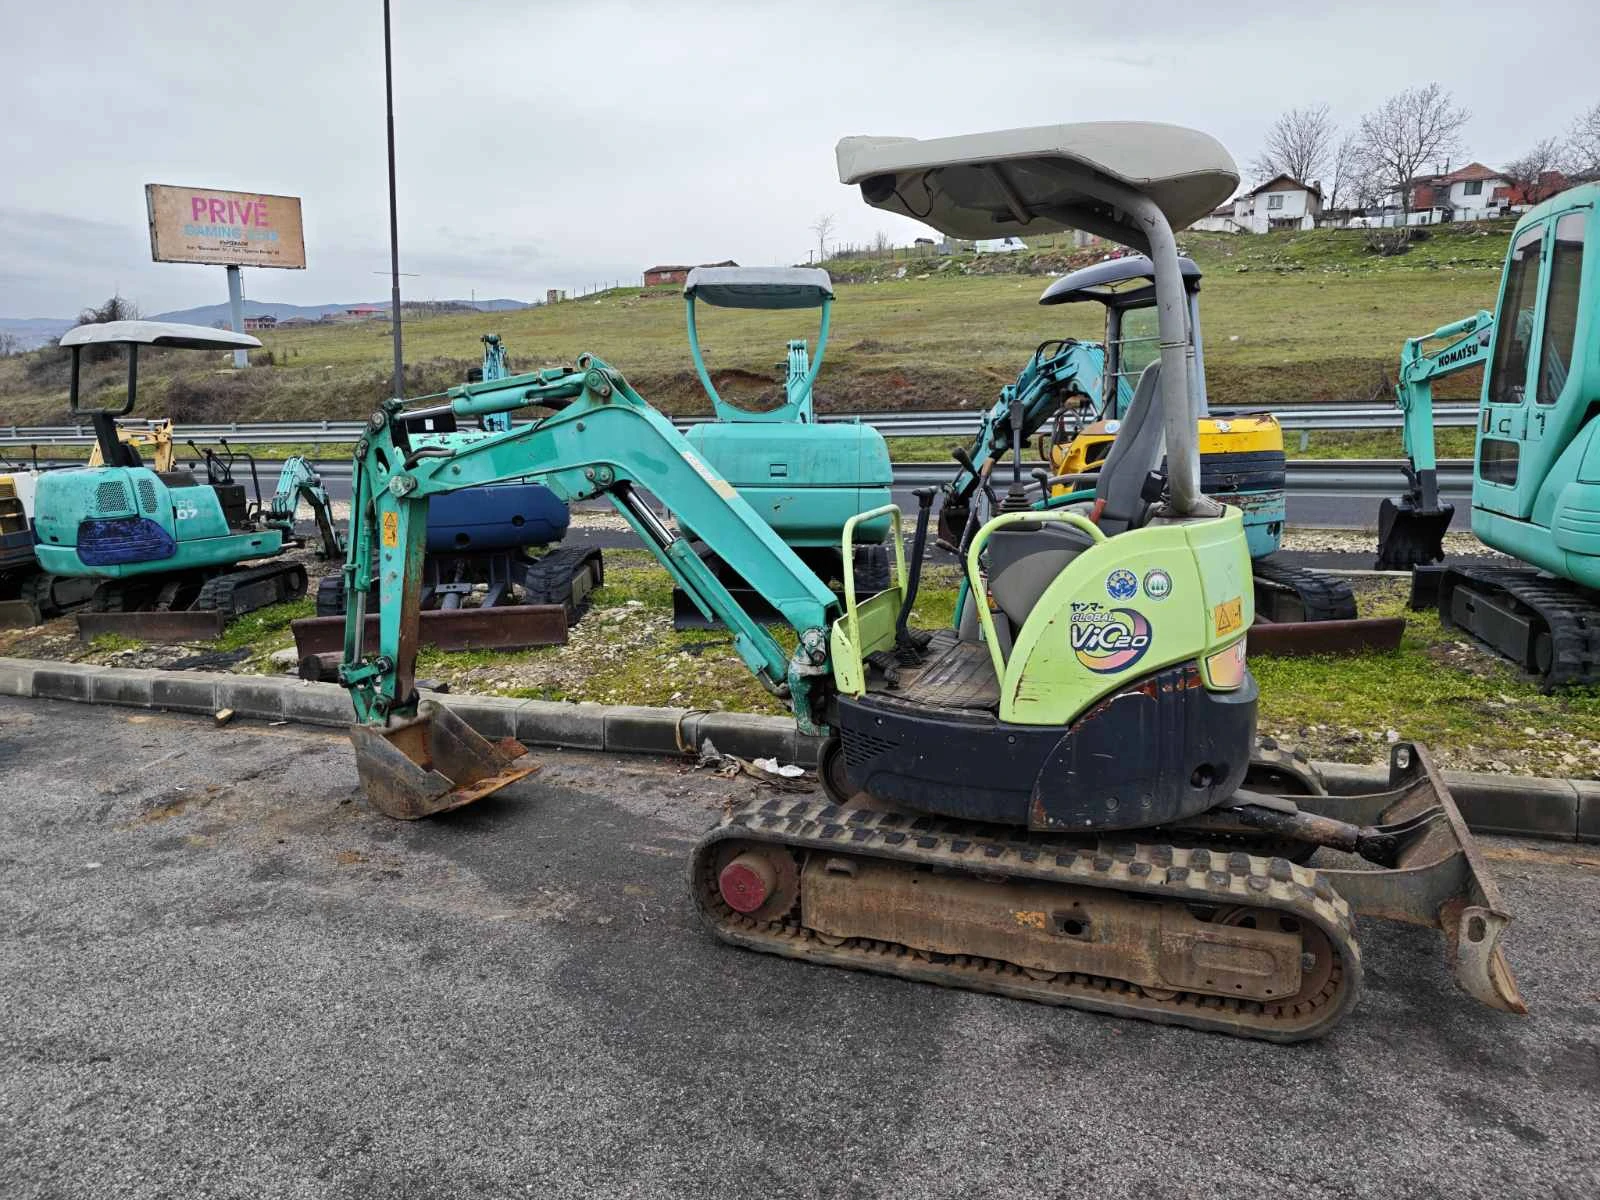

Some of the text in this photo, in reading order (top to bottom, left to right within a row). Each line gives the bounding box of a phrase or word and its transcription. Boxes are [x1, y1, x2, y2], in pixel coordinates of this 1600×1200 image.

[191, 195, 270, 227] PRIVÉ
[1438, 343, 1478, 367] KOMATSU
[1070, 602, 1104, 612] ヤンマー
[1071, 613, 1115, 622] GLOBAL
